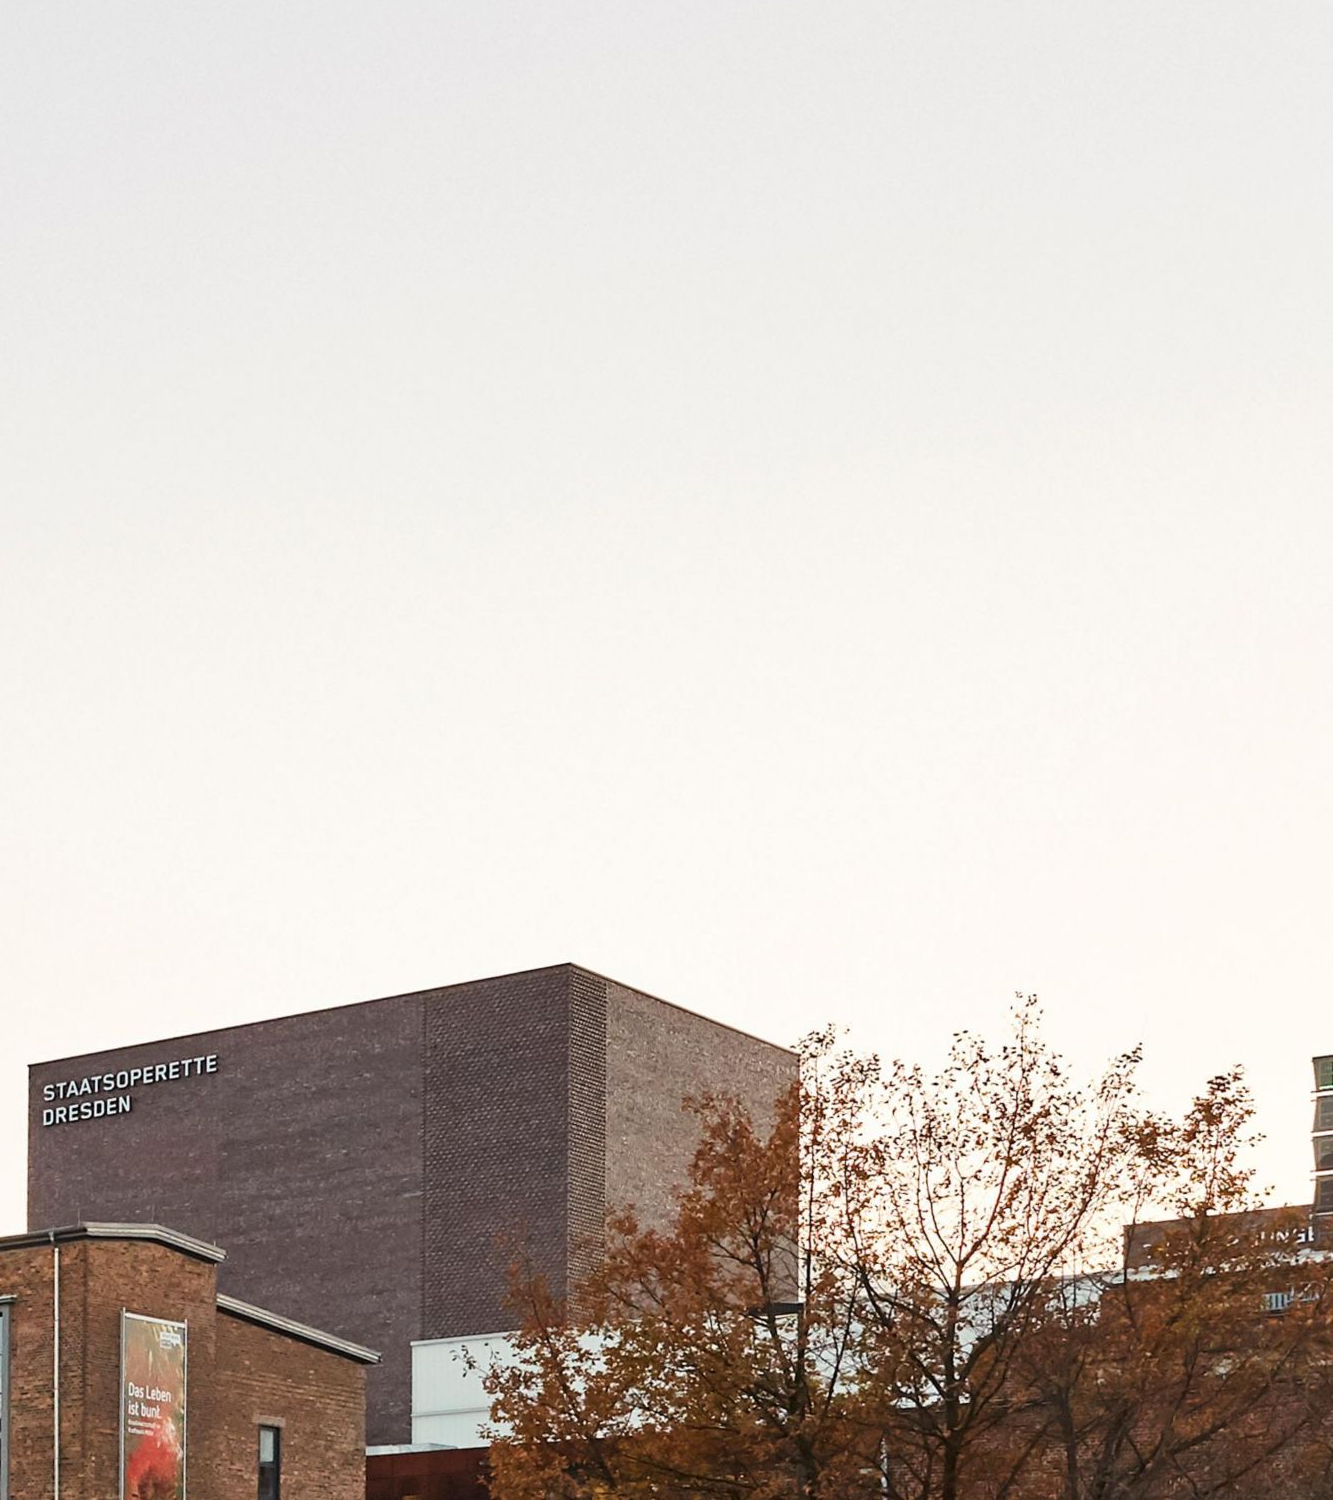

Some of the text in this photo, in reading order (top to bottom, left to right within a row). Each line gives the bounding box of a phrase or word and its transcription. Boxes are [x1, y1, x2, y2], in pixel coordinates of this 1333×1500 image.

[42, 1054, 218, 1102] STAATSOPERETTE
[42, 1095, 131, 1126] DRESDEN
[128, 1382, 172, 1403] Das Leben
[128, 1401, 139, 1416] ist
